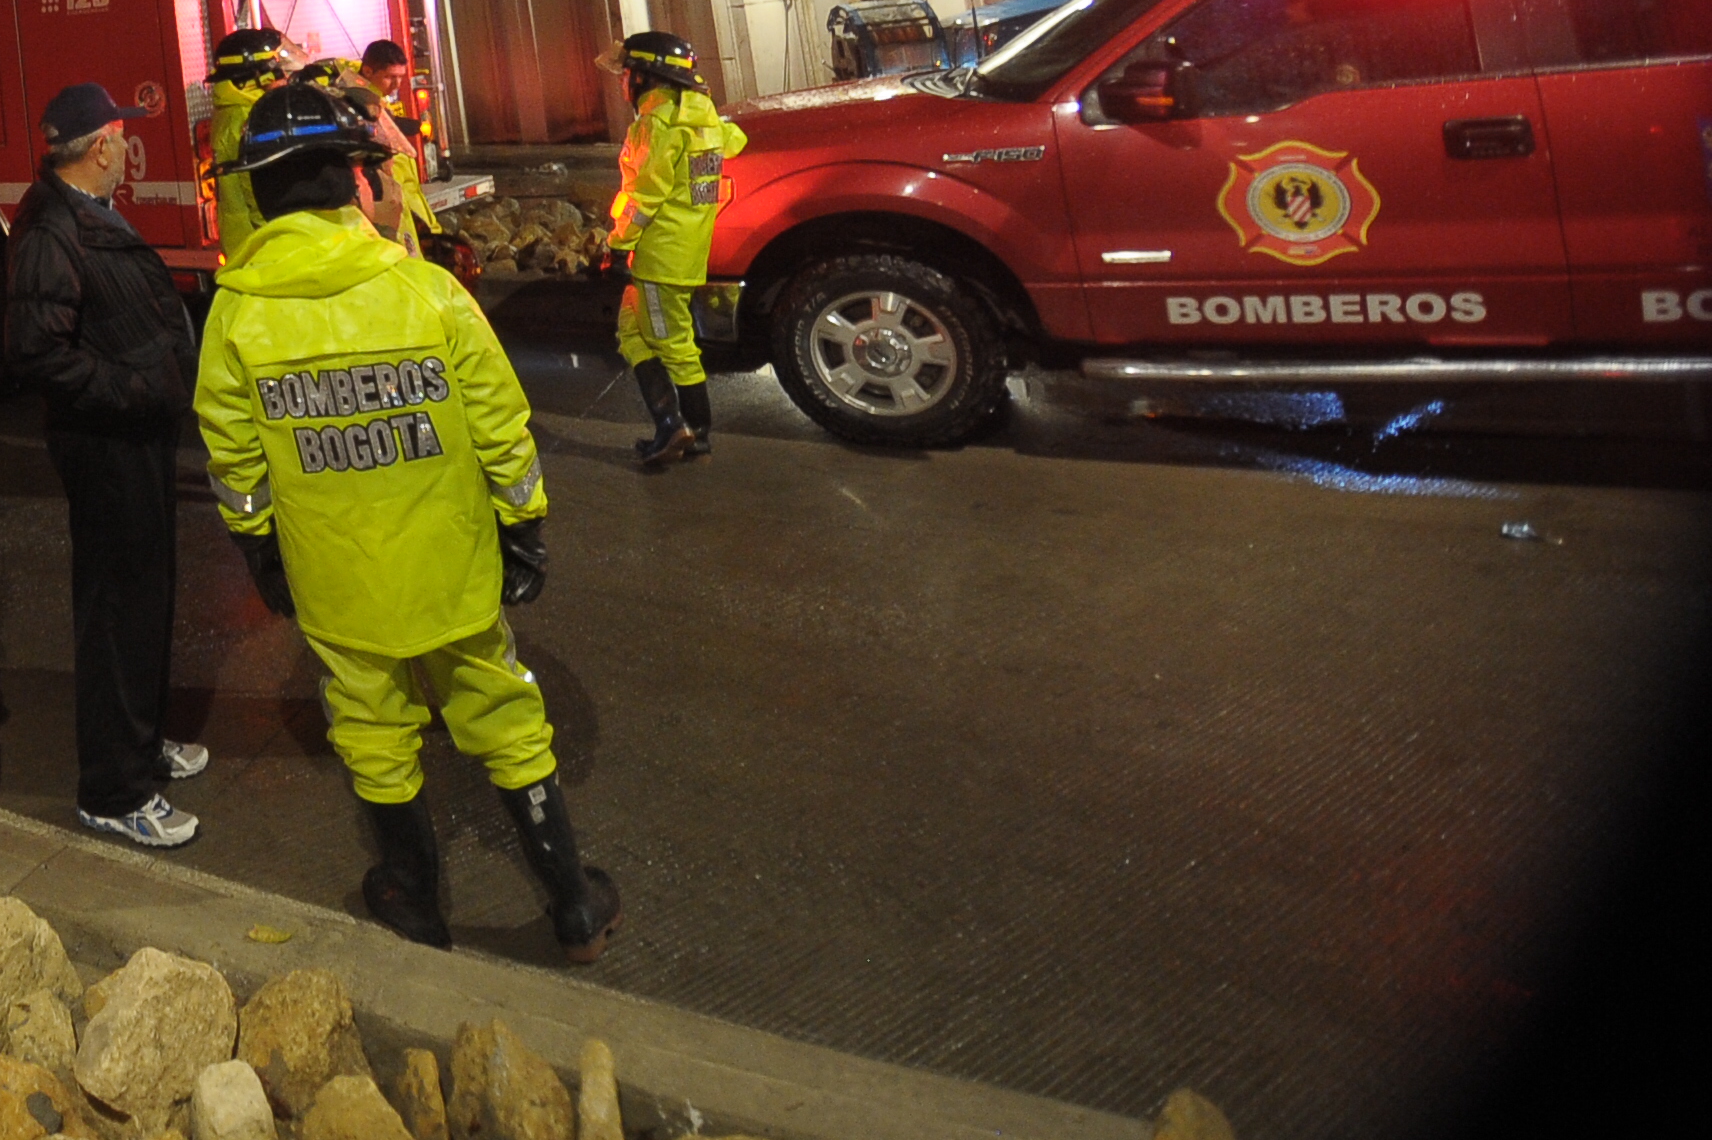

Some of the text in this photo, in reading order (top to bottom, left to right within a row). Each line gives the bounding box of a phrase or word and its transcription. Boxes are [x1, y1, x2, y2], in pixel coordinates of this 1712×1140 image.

[128, 135, 146, 180] 9
[1165, 291, 1487, 325] BOMBEROS
[256, 356, 449, 420] BOMBEROS
[292, 411, 444, 474] BOGOTA
